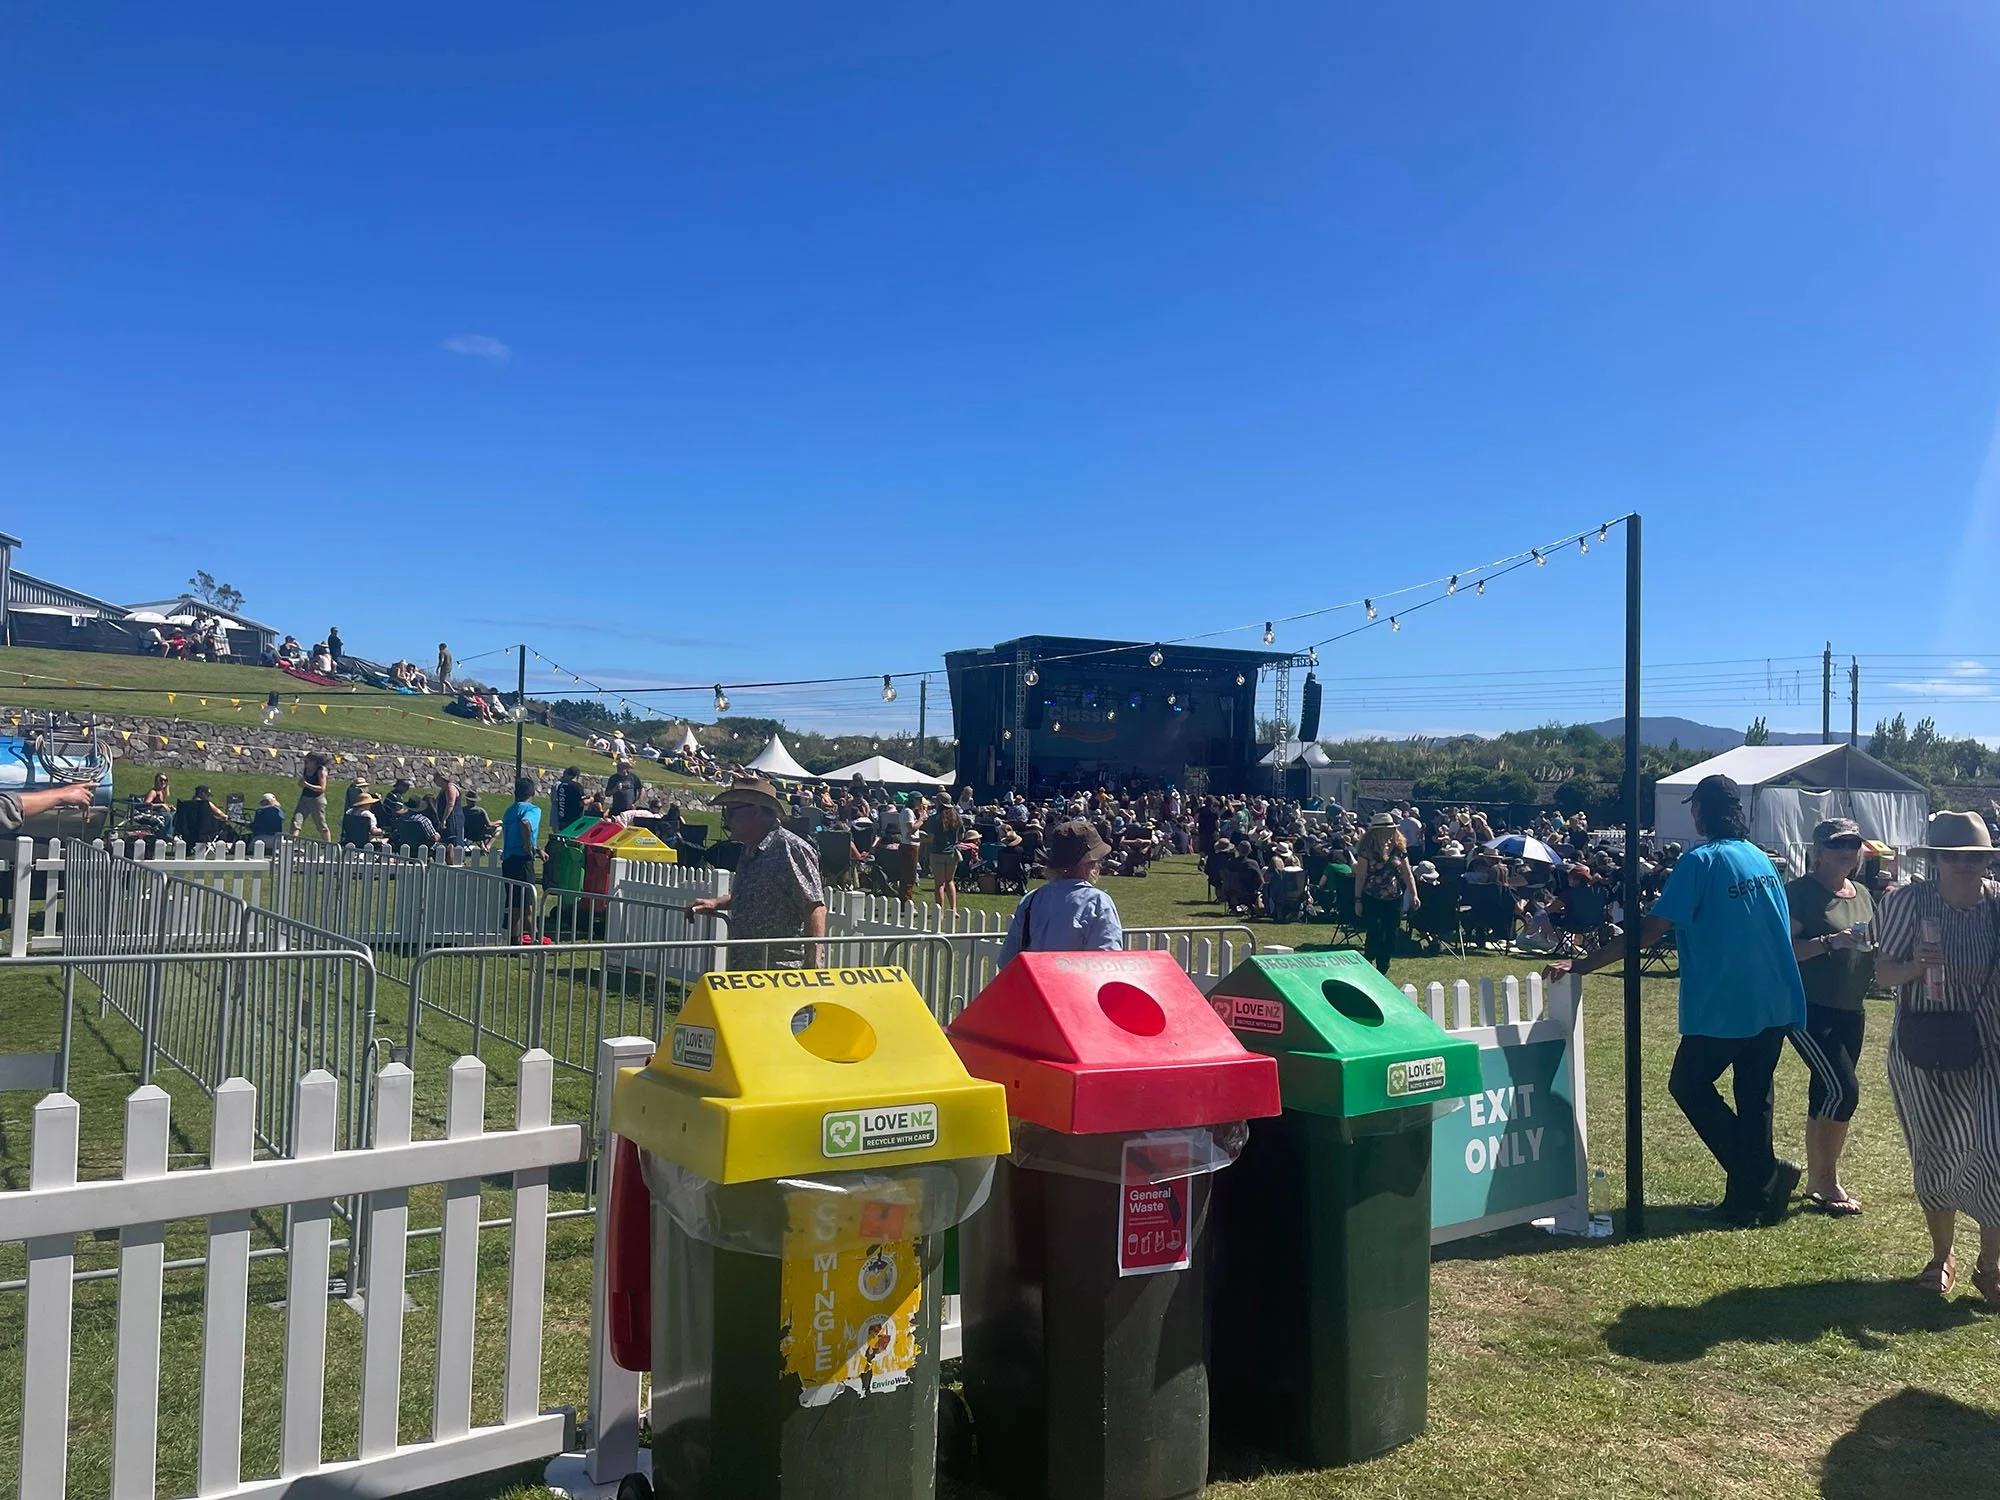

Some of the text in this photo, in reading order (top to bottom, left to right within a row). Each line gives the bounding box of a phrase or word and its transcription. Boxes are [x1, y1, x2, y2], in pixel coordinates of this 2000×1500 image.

[1329, 953, 1364, 967] ONLY
[708, 968, 904, 991] RECYCLE ONLY
[1235, 1002, 1281, 1018] LOVE NZ
[686, 1032, 713, 1049] LOVE NZ
[1408, 1061, 1444, 1078] LOVE NZ
[1469, 1084, 1534, 1127] EXIT
[864, 1110, 933, 1132] LOVE NZ
[866, 1133, 931, 1147] RECYCLE WITH CARE
[1464, 1127, 1544, 1174] ONLY
[1129, 1187, 1171, 1201] General
[1129, 1202, 1164, 1214] Waste
